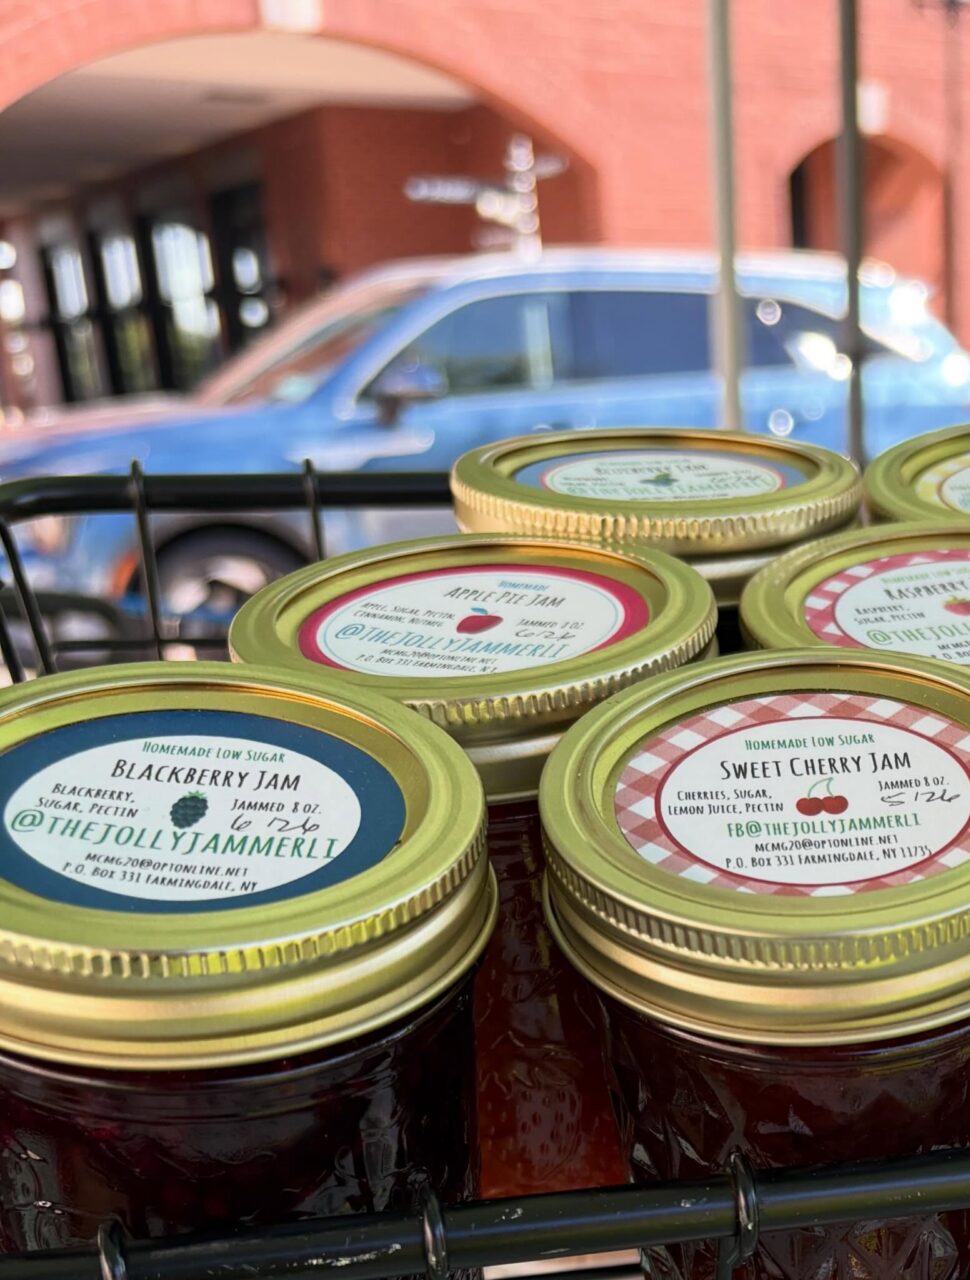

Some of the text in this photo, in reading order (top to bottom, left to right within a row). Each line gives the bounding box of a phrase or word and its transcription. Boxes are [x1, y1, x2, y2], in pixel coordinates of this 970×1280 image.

[443, 587, 566, 608] APPLE PIE JAM
[883, 579, 970, 601] RASPBERRY
[334, 623, 570, 658] @THEJOLLYJAMMERLI
[142, 740, 286, 763] HOMEMADE LOW SUGAR
[745, 733, 875, 751] HOMEMADE LOW SUGAR
[111, 758, 301, 791] BLACKBERRY JAM
[720, 752, 912, 780] SWEET CHERRY JAM
[52, 783, 135, 803] BLACKBERRY,
[878, 778, 921, 791] JAMMED
[924, 776, 930, 787] 8
[677, 788, 772, 801] CHERRIES, SUGAR,
[35, 797, 139, 818] SUGAR, PECTIN
[230, 799, 285, 813] JAMMED
[292, 802, 300, 813] 8
[668, 802, 784, 816] LEMON JUICE, PECTIN
[11, 809, 339, 860] @THEJOLLYJAMMERLI
[727, 812, 921, 838] FB@THEJOLLYJAMMERLI
[755, 834, 898, 853] MCMG20@OPTONLINE.NET
[85, 853, 248, 877] MCMG20@OPTONLINE.NET
[725, 857, 748, 869] P.O.
[751, 857, 772, 868] BOX
[775, 855, 795, 866] 331
[798, 850, 880, 866] FARMINGDALE,
[883, 848, 897, 860] NY
[91, 867, 115, 879] BOX
[120, 870, 141, 883] 331
[145, 873, 236, 892] FARMINGDALE,
[240, 881, 258, 892] NY
